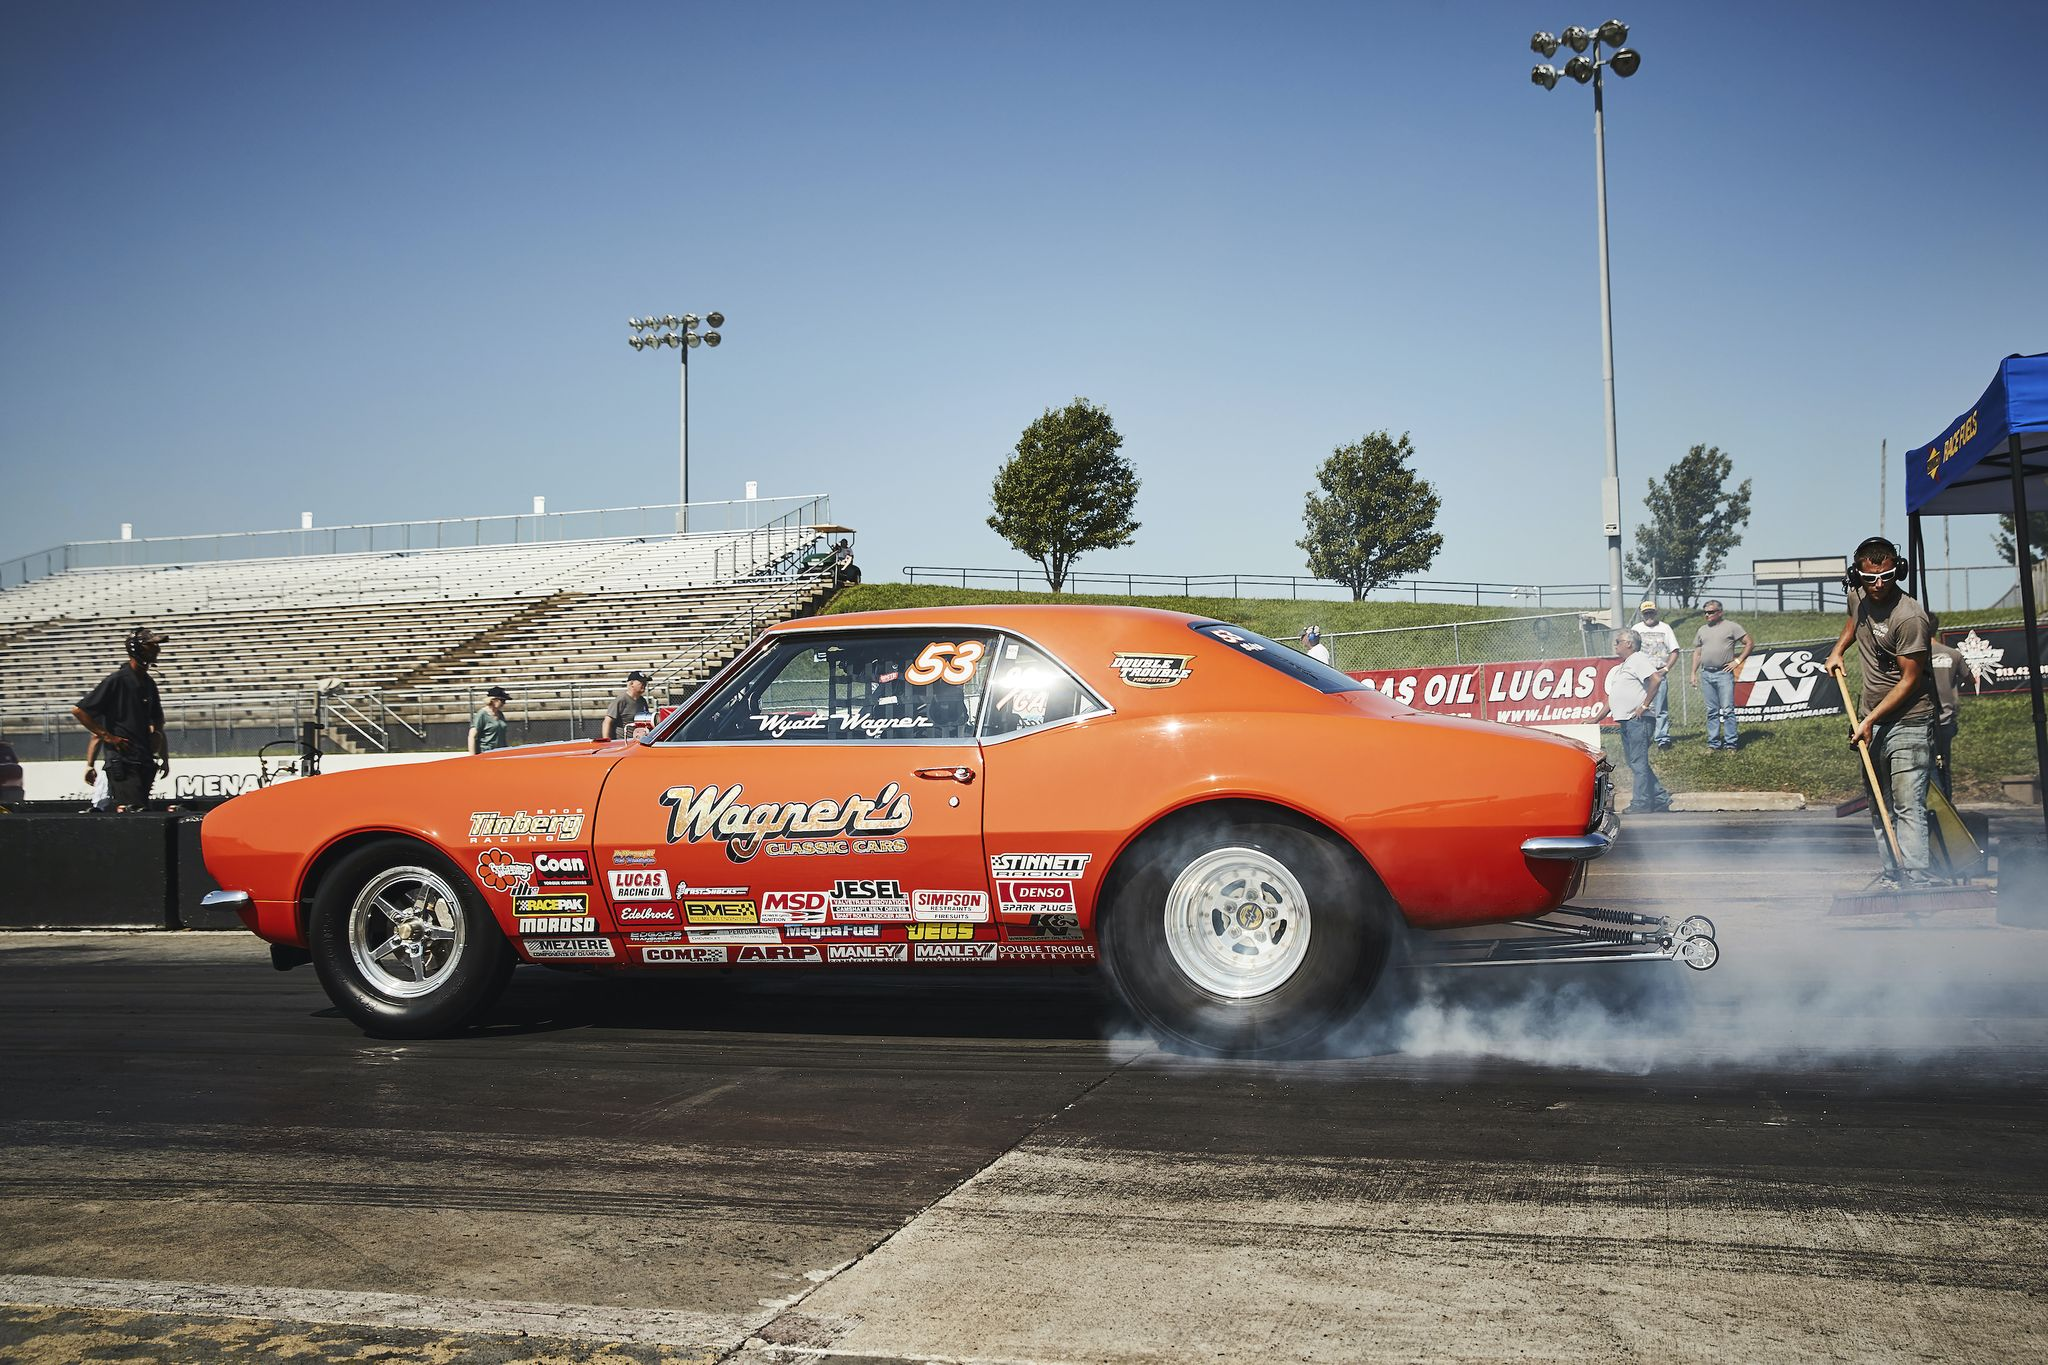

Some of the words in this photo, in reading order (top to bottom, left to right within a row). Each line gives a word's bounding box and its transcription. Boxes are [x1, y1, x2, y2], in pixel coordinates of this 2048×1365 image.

[905, 641, 985, 685] 53
[1110, 657, 1174, 669] DOUBLE
[1119, 668, 1192, 679] TROUBLE
[1424, 674, 1475, 706] OIL
[1488, 666, 1598, 702] LUCAS
[750, 714, 829, 738] Wyatt
[830, 713, 934, 737] Wagner
[468, 810, 585, 842] Tinberg
[659, 782, 913, 864] Wagner's
[469, 836, 554, 844] RACING
[766, 840, 849, 856] CLASSIC
[852, 838, 908, 855] CARS
[535, 854, 585, 872] Coan
[1001, 855, 1090, 870] STINNETT
[616, 873, 662, 887] LUCAS
[618, 888, 650, 896] RACING
[651, 887, 664, 896] OIL
[830, 881, 904, 898] JESEL
[1020, 887, 1064, 897] DENSO
[528, 899, 583, 910] RACEPAK
[765, 894, 825, 910] MSD
[918, 893, 982, 906] SIMPSON
[621, 907, 675, 919] Edelbrock
[688, 904, 742, 916] BME
[519, 917, 595, 932] MOROSO
[785, 924, 879, 939] MagnaFuel
[907, 923, 974, 939] JEGS
[540, 940, 608, 950] MEZIERE
[829, 946, 896, 958] MANLEY
[917, 945, 985, 957] MANLEY
[647, 949, 706, 960] COMP
[739, 946, 817, 959] ARP
